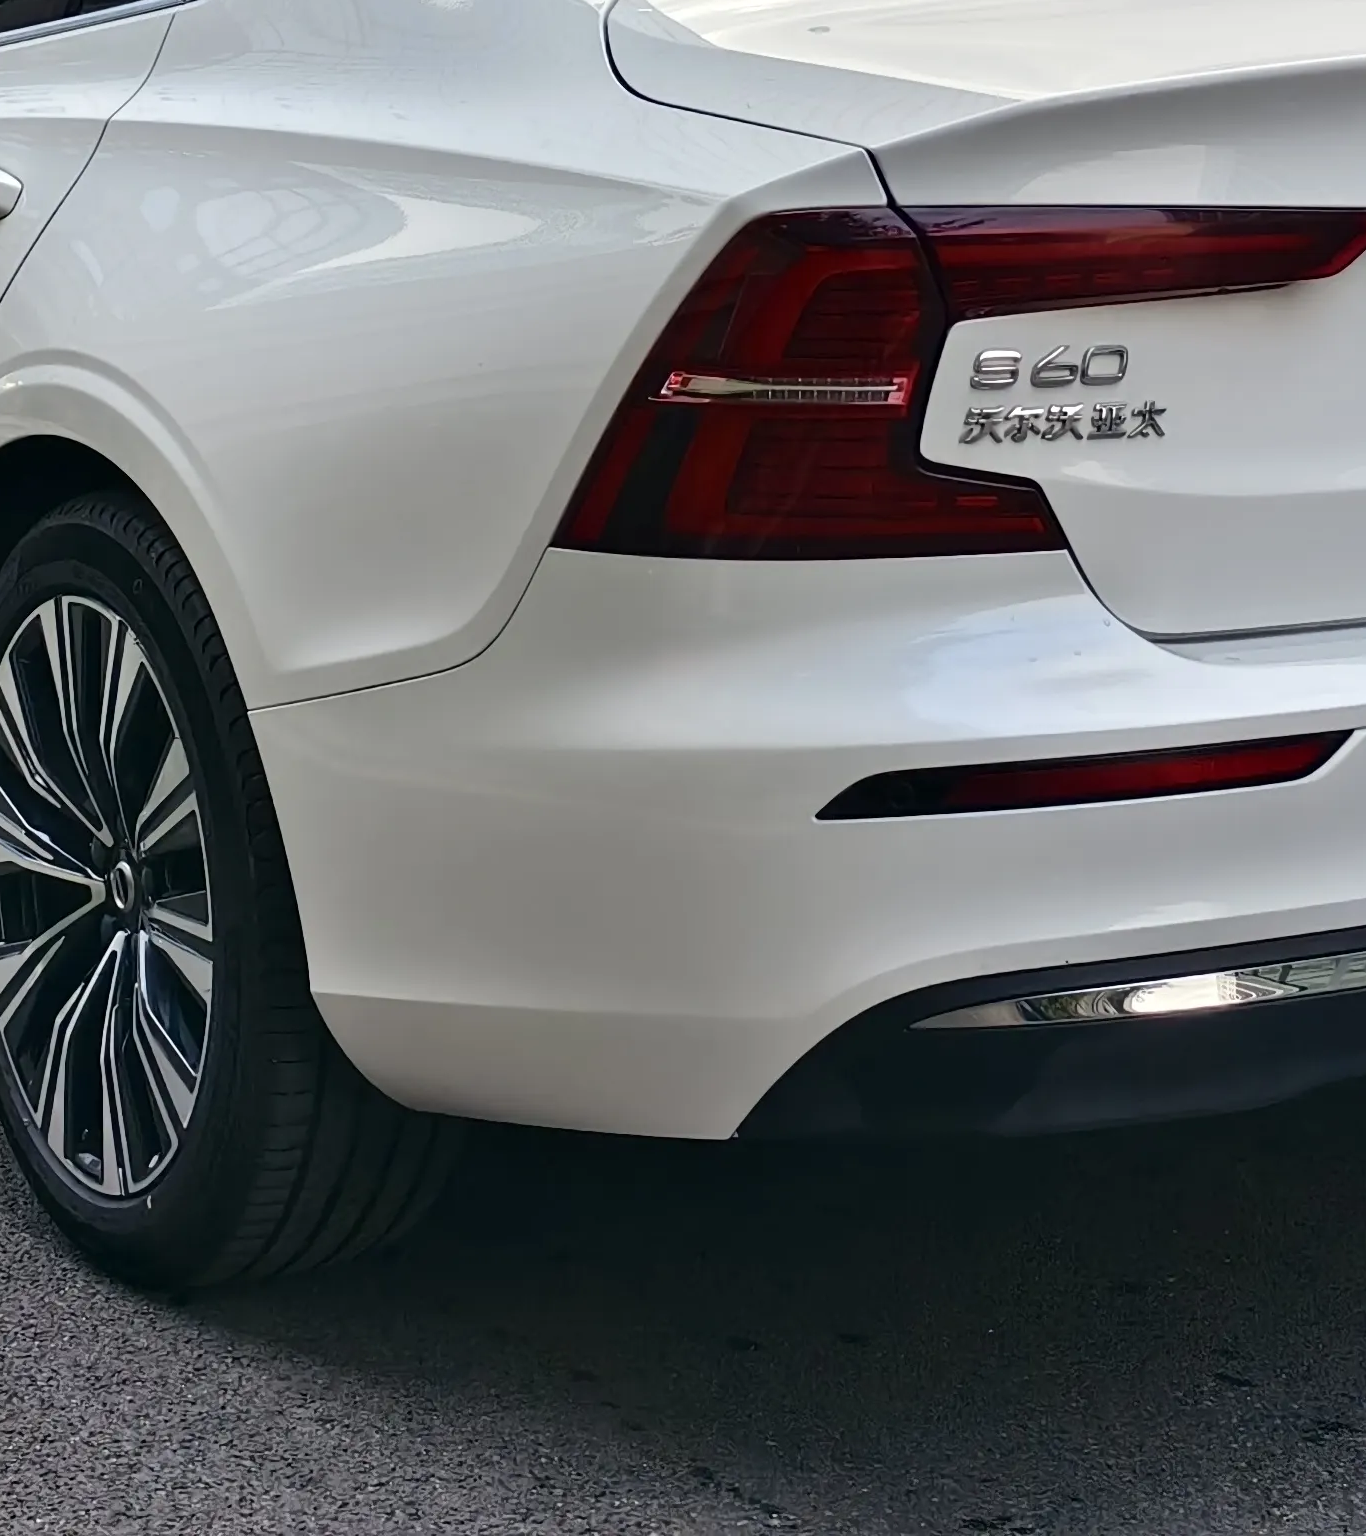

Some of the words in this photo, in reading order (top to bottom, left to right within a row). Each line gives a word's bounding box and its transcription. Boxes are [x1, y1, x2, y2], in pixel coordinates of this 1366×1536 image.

[969, 344, 1129, 391] S60
[959, 400, 1167, 444] 沃尔沃亚太
